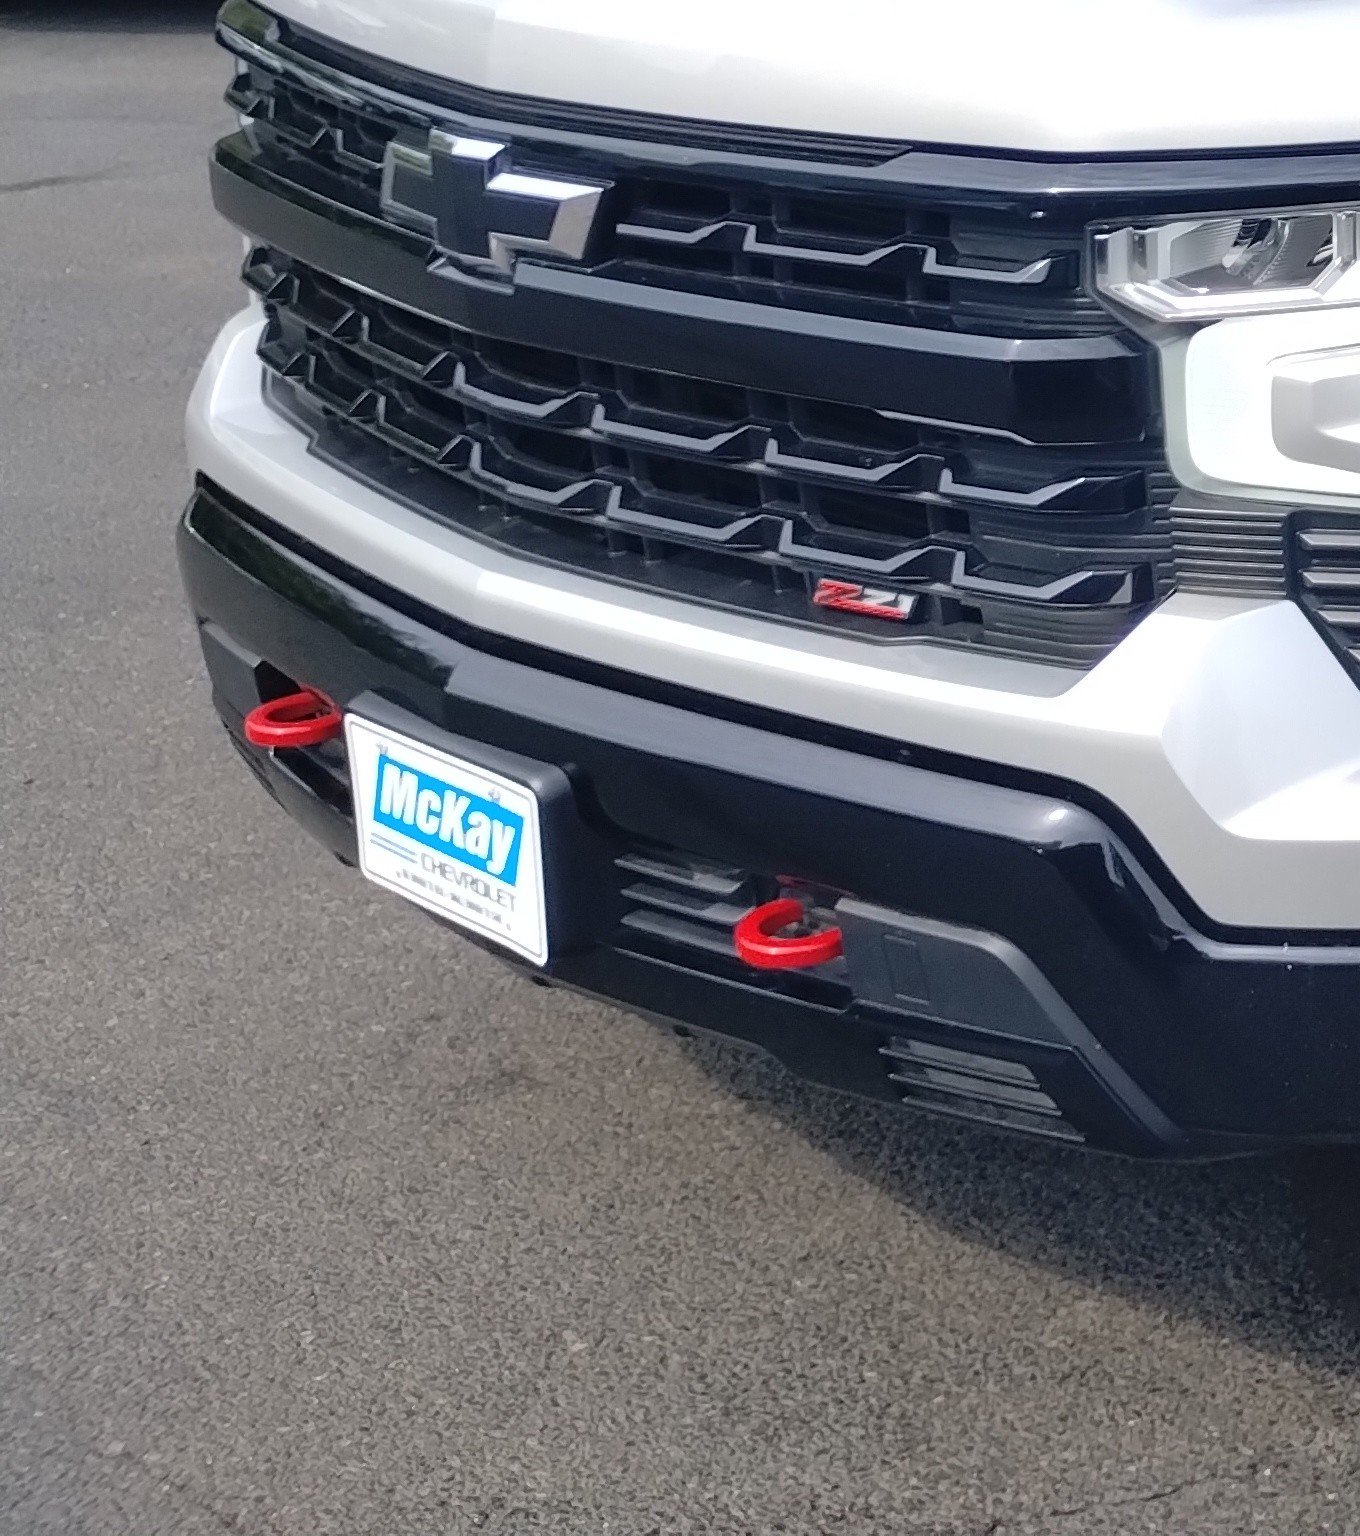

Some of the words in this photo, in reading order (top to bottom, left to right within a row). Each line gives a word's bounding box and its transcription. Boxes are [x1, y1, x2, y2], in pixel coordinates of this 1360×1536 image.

[813, 578, 920, 620] Z71
[379, 761, 517, 876] McKay
[420, 851, 517, 913] CHEVROLET
